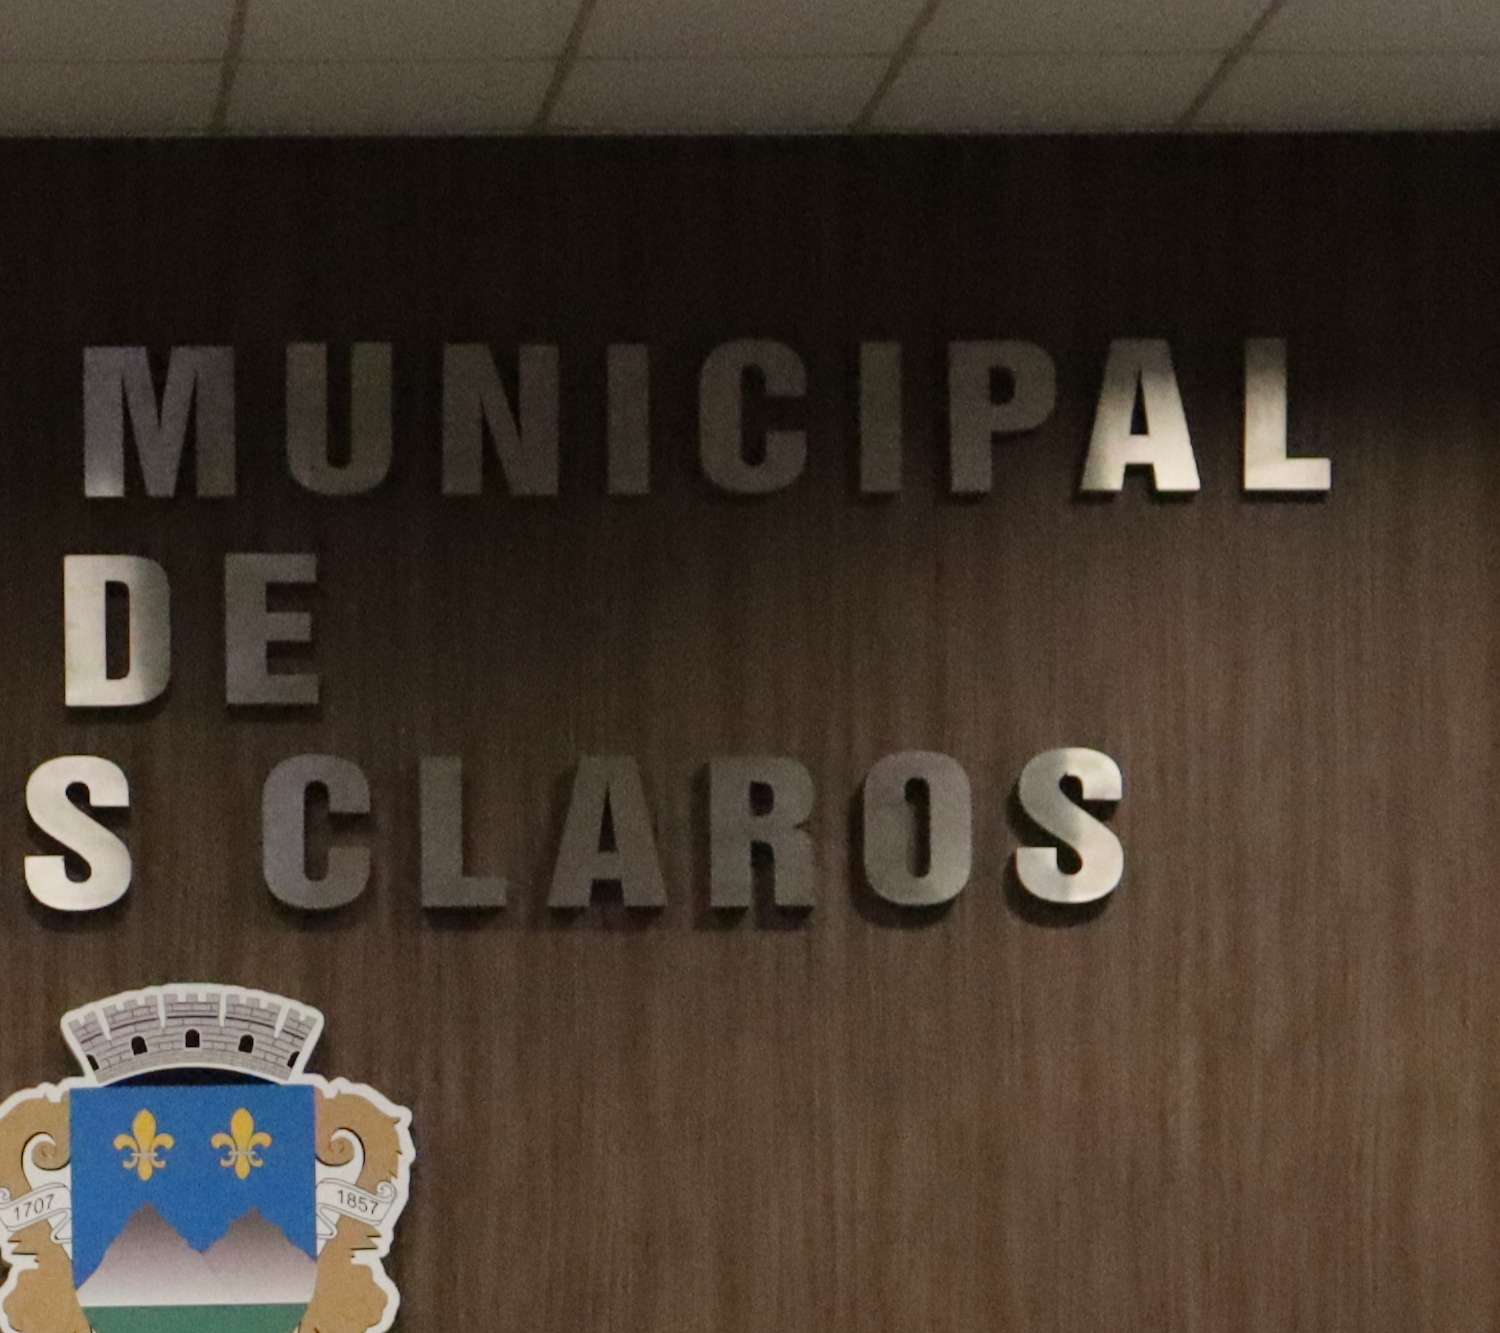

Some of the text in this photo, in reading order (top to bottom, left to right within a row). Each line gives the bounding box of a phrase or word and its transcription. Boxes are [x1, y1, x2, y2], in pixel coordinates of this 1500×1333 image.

[80, 336, 1333, 499] MUNICIPAL
[62, 551, 321, 708] DE
[259, 746, 1126, 911] CLAROS
[12, 1193, 57, 1222] 1707
[336, 1188, 380, 1216] 1857
